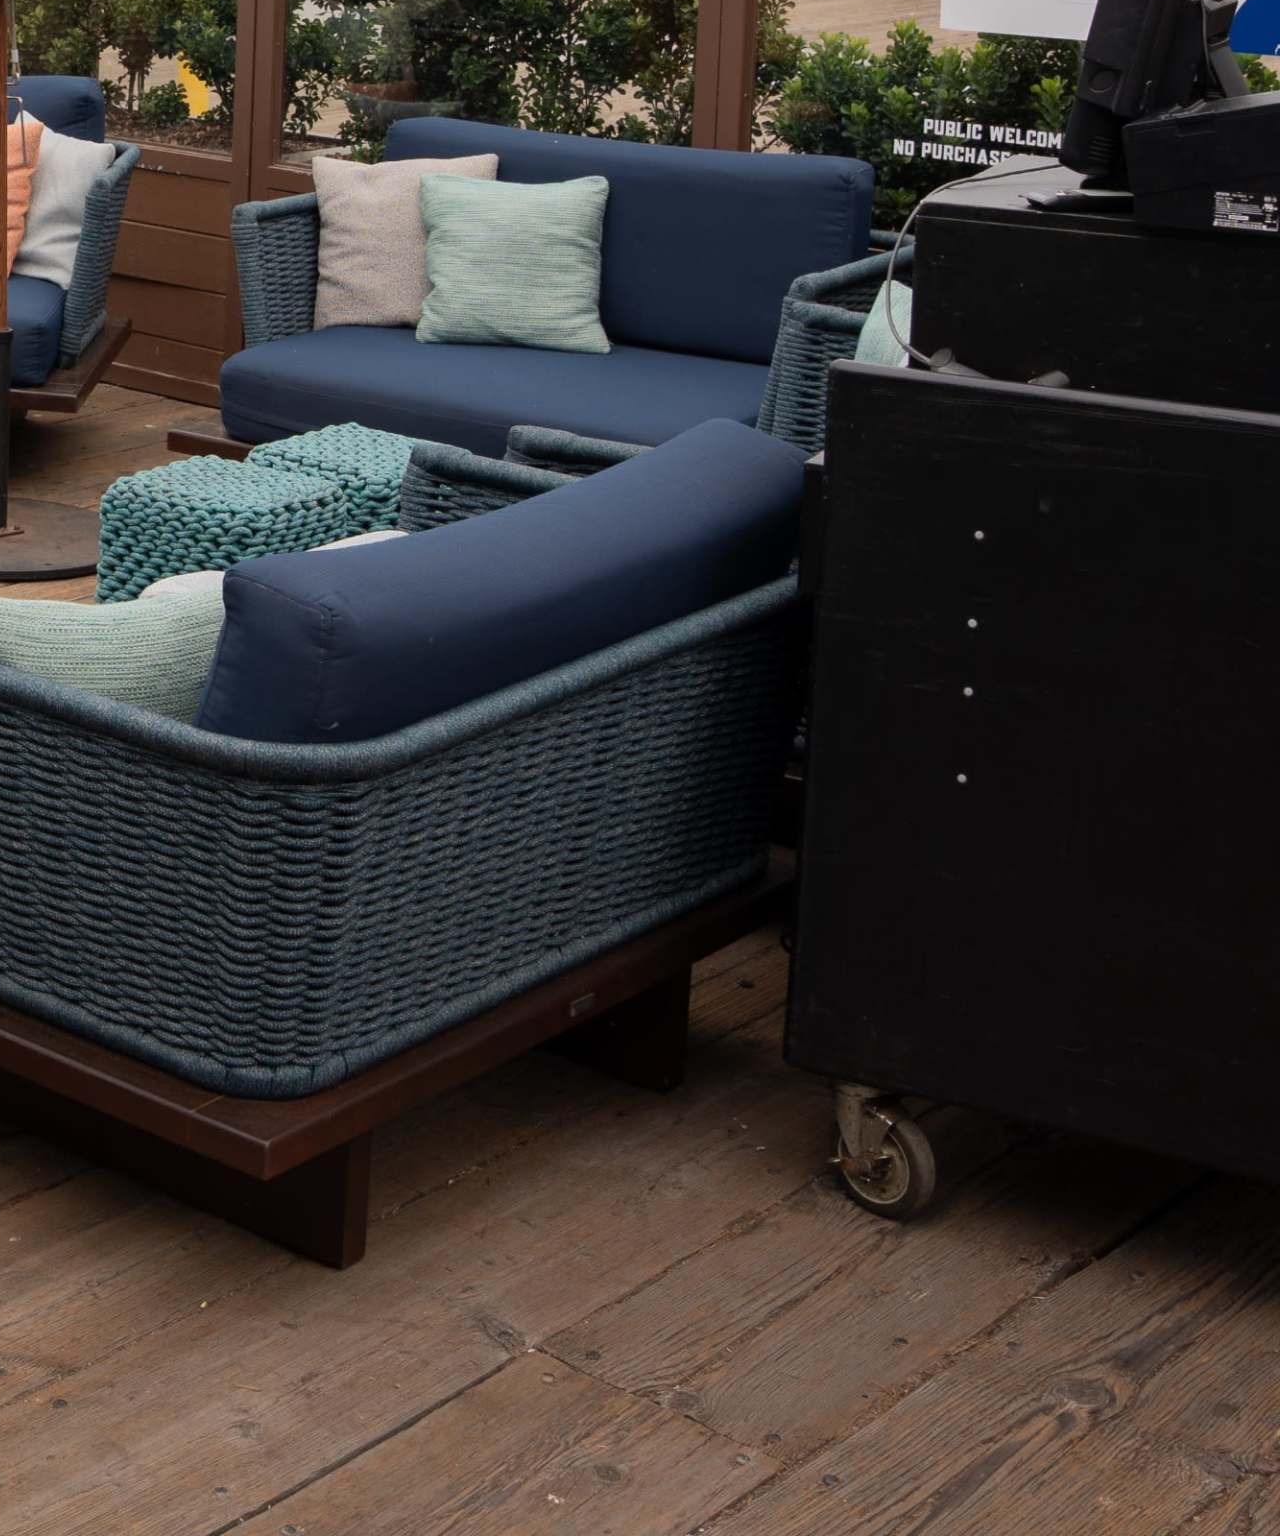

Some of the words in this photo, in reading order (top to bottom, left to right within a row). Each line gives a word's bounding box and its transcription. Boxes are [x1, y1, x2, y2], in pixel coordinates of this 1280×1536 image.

[923, 118, 983, 140] PUBLIC
[989, 125, 1064, 149] WELCOM
[893, 138, 915, 157] NO
